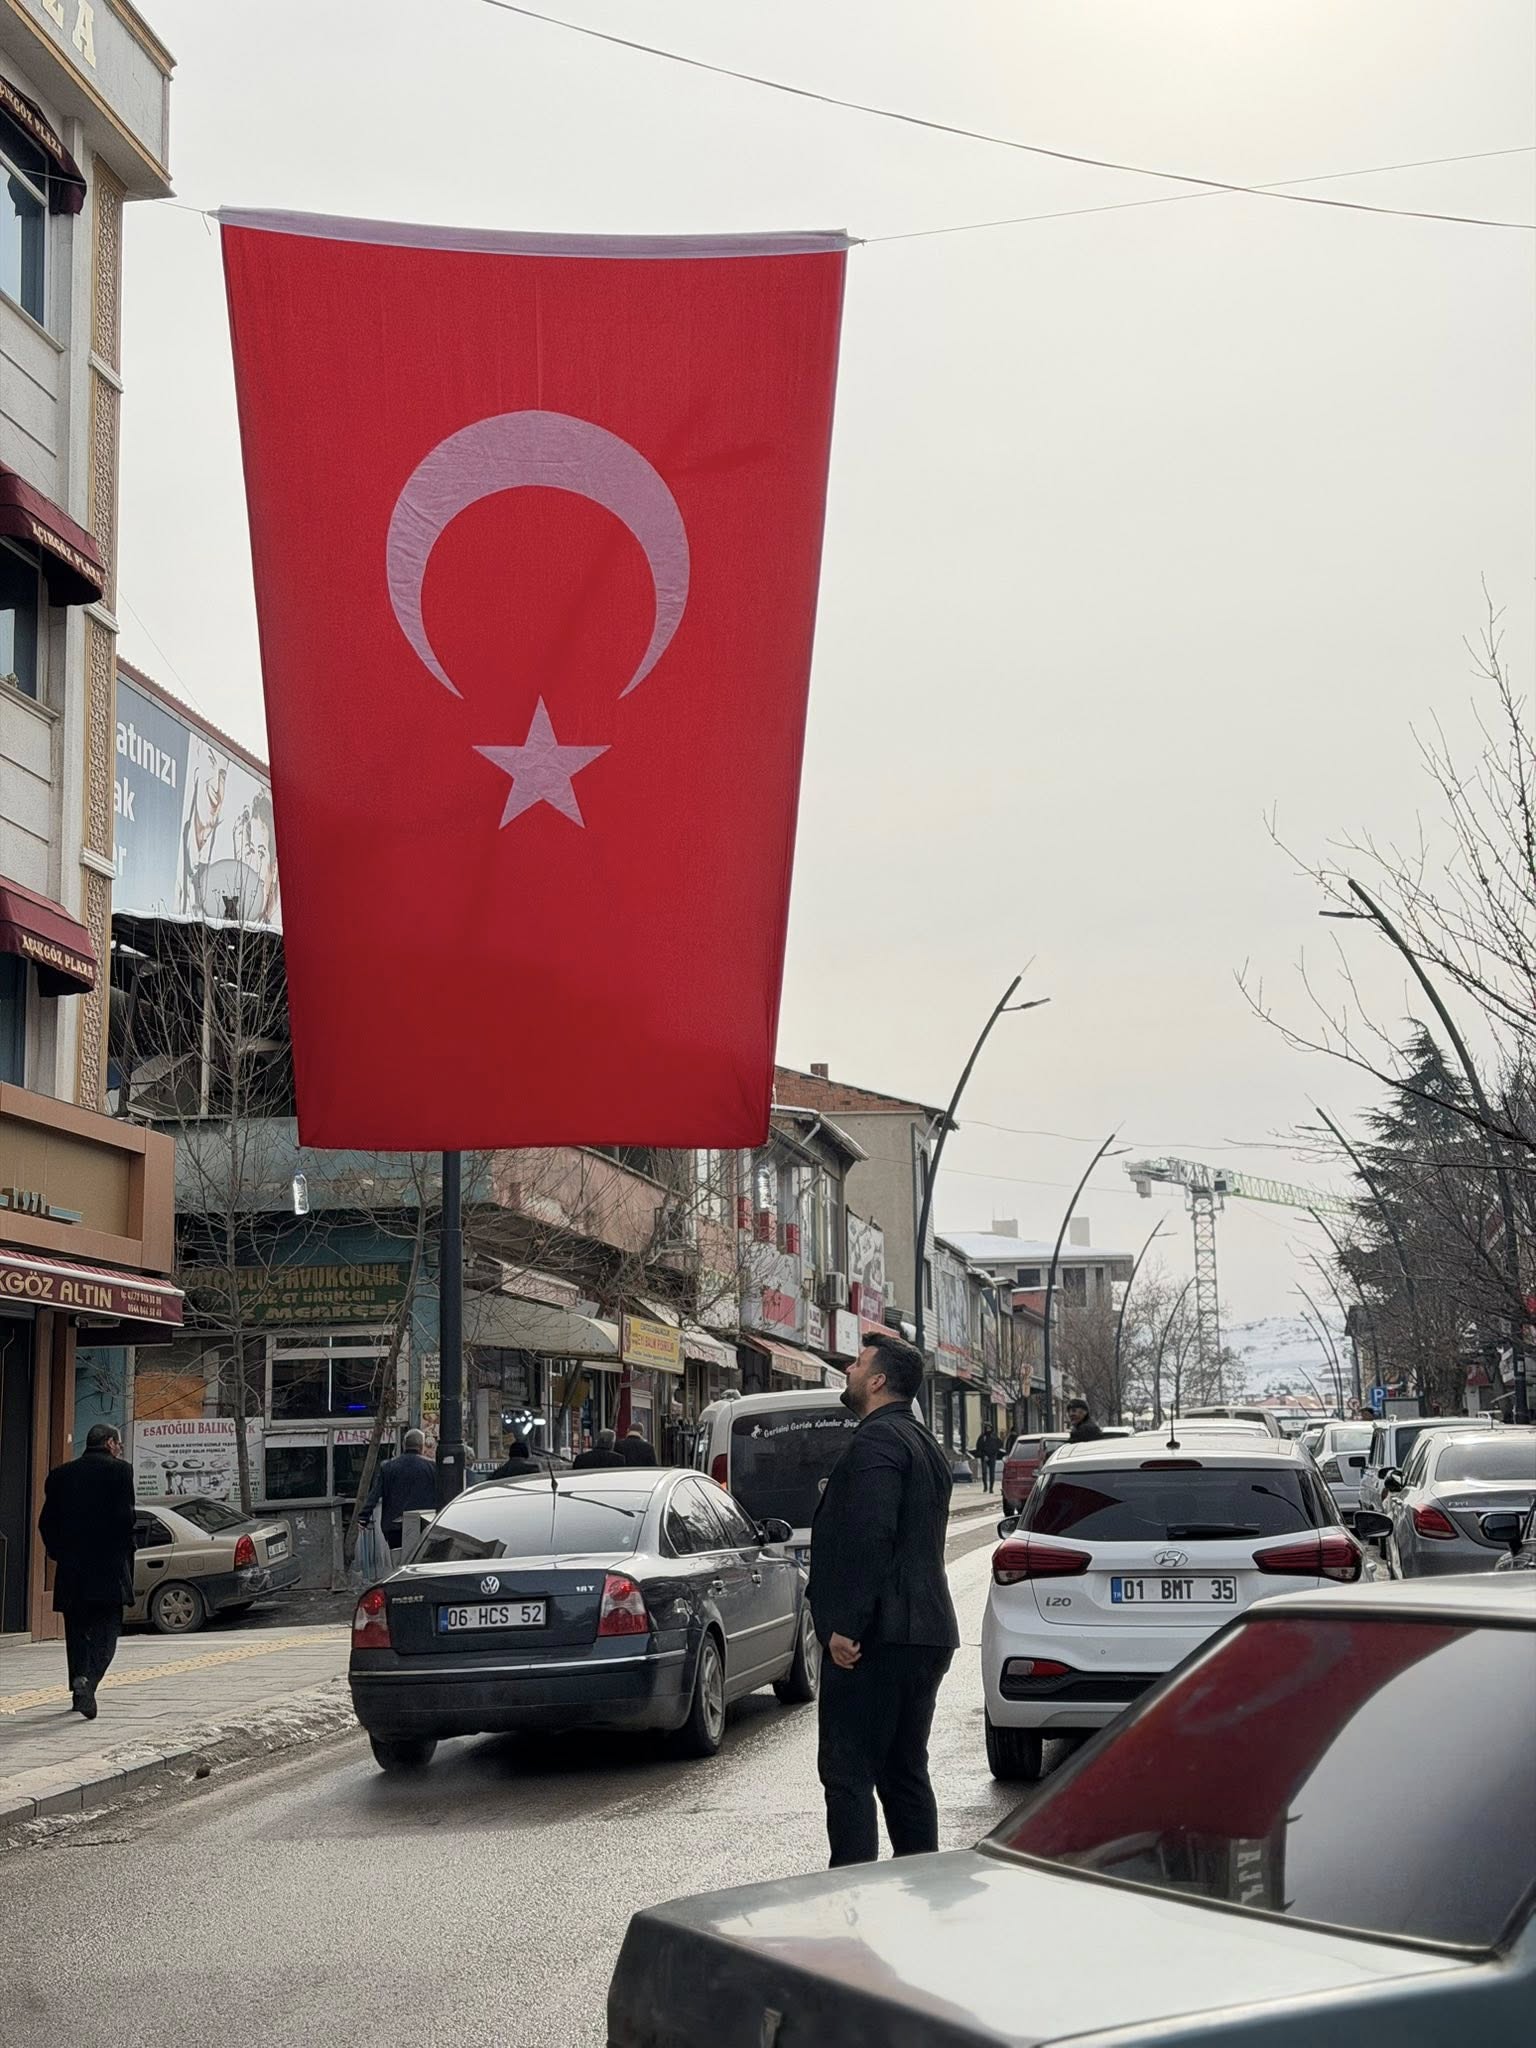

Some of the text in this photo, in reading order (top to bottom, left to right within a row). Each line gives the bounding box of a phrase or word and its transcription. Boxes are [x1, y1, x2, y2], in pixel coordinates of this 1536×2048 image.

[65, 953, 94, 980] PLAZA
[60, 1281, 112, 1309] ALTIN
[1374, 1388, 1385, 1401] P
[143, 1421, 256, 1437] ESATOĞLU BALIKÇK
[1124, 1579, 1234, 1600] 01 BMT 35
[449, 1604, 541, 1627] 06 HCS 52
